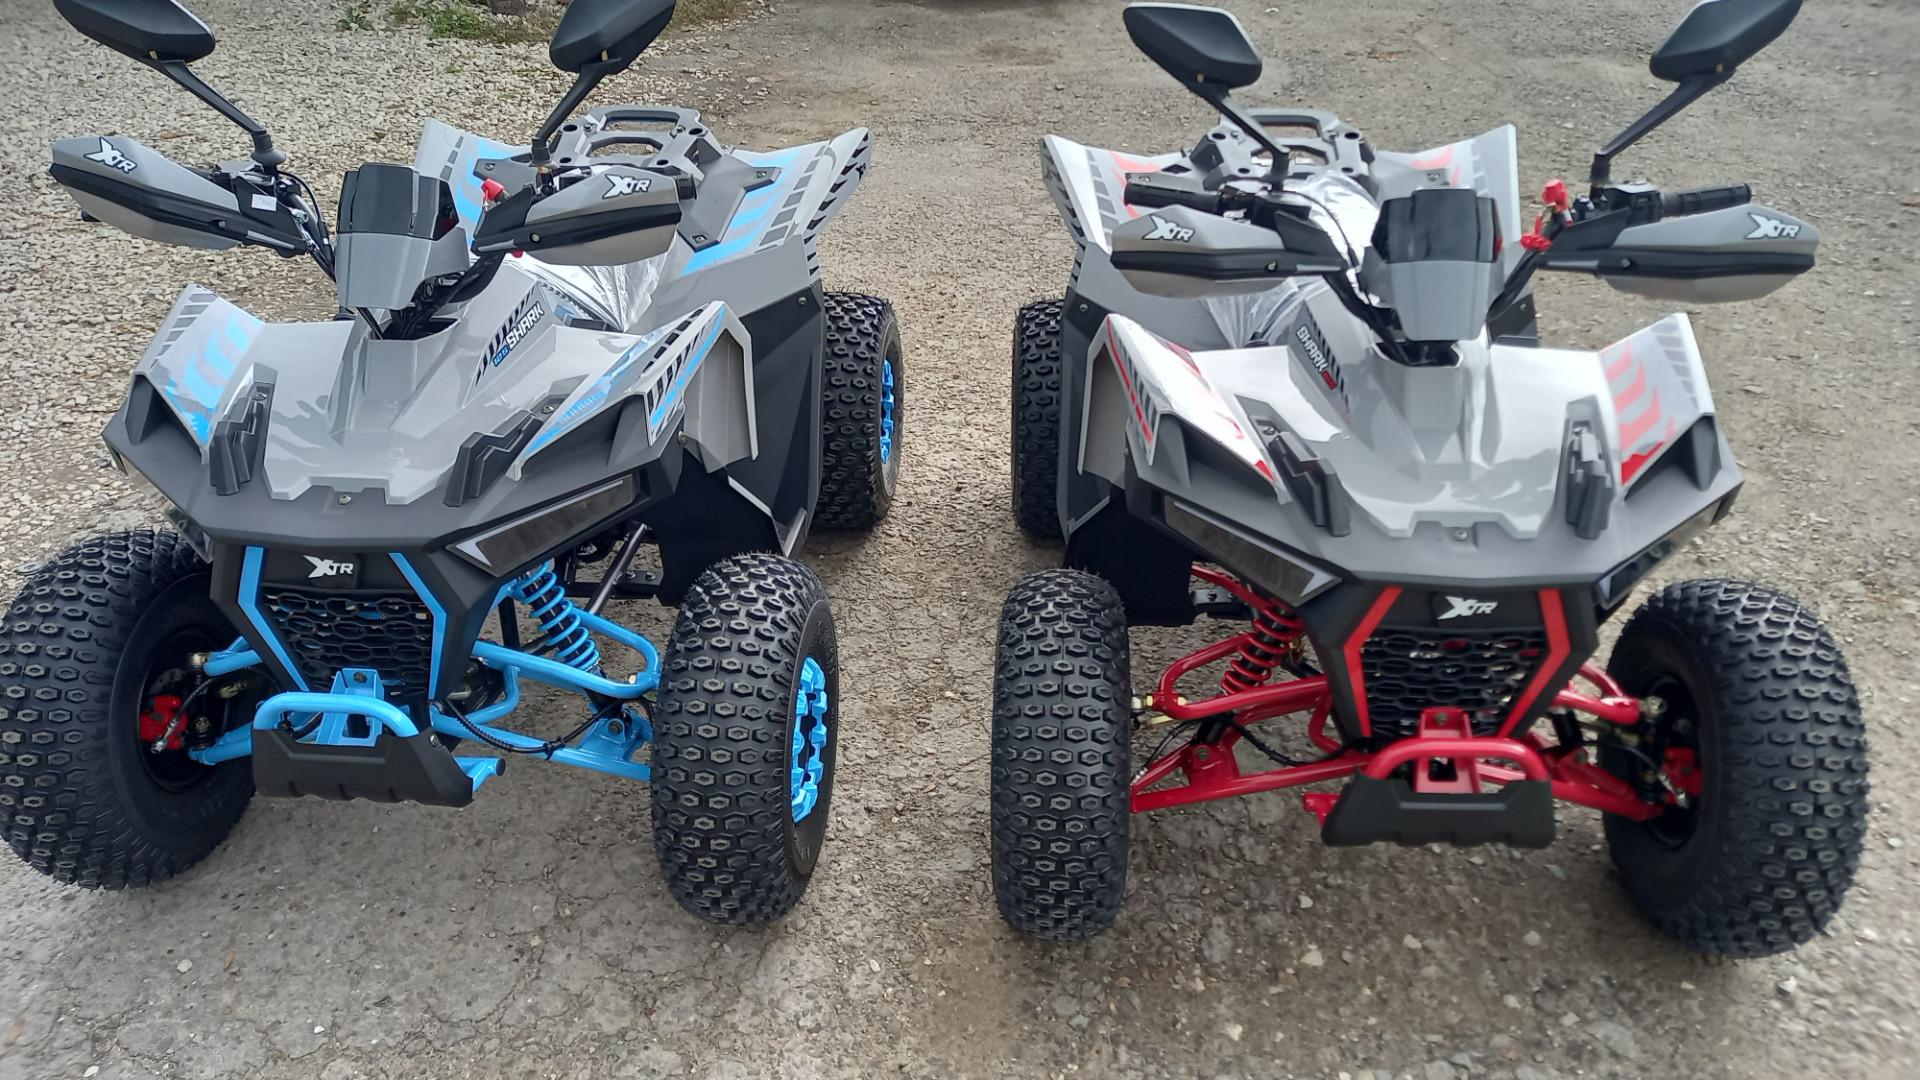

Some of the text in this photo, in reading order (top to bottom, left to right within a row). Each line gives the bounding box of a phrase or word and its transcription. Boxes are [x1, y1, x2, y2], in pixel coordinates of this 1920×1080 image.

[84, 137, 137, 173] XTR
[602, 174, 651, 199] XTR
[1142, 214, 1195, 242] XTR
[1744, 213, 1800, 239] XTR
[505, 301, 544, 351] SHARK
[302, 555, 354, 578] XTR
[1437, 596, 1498, 620] XTR
